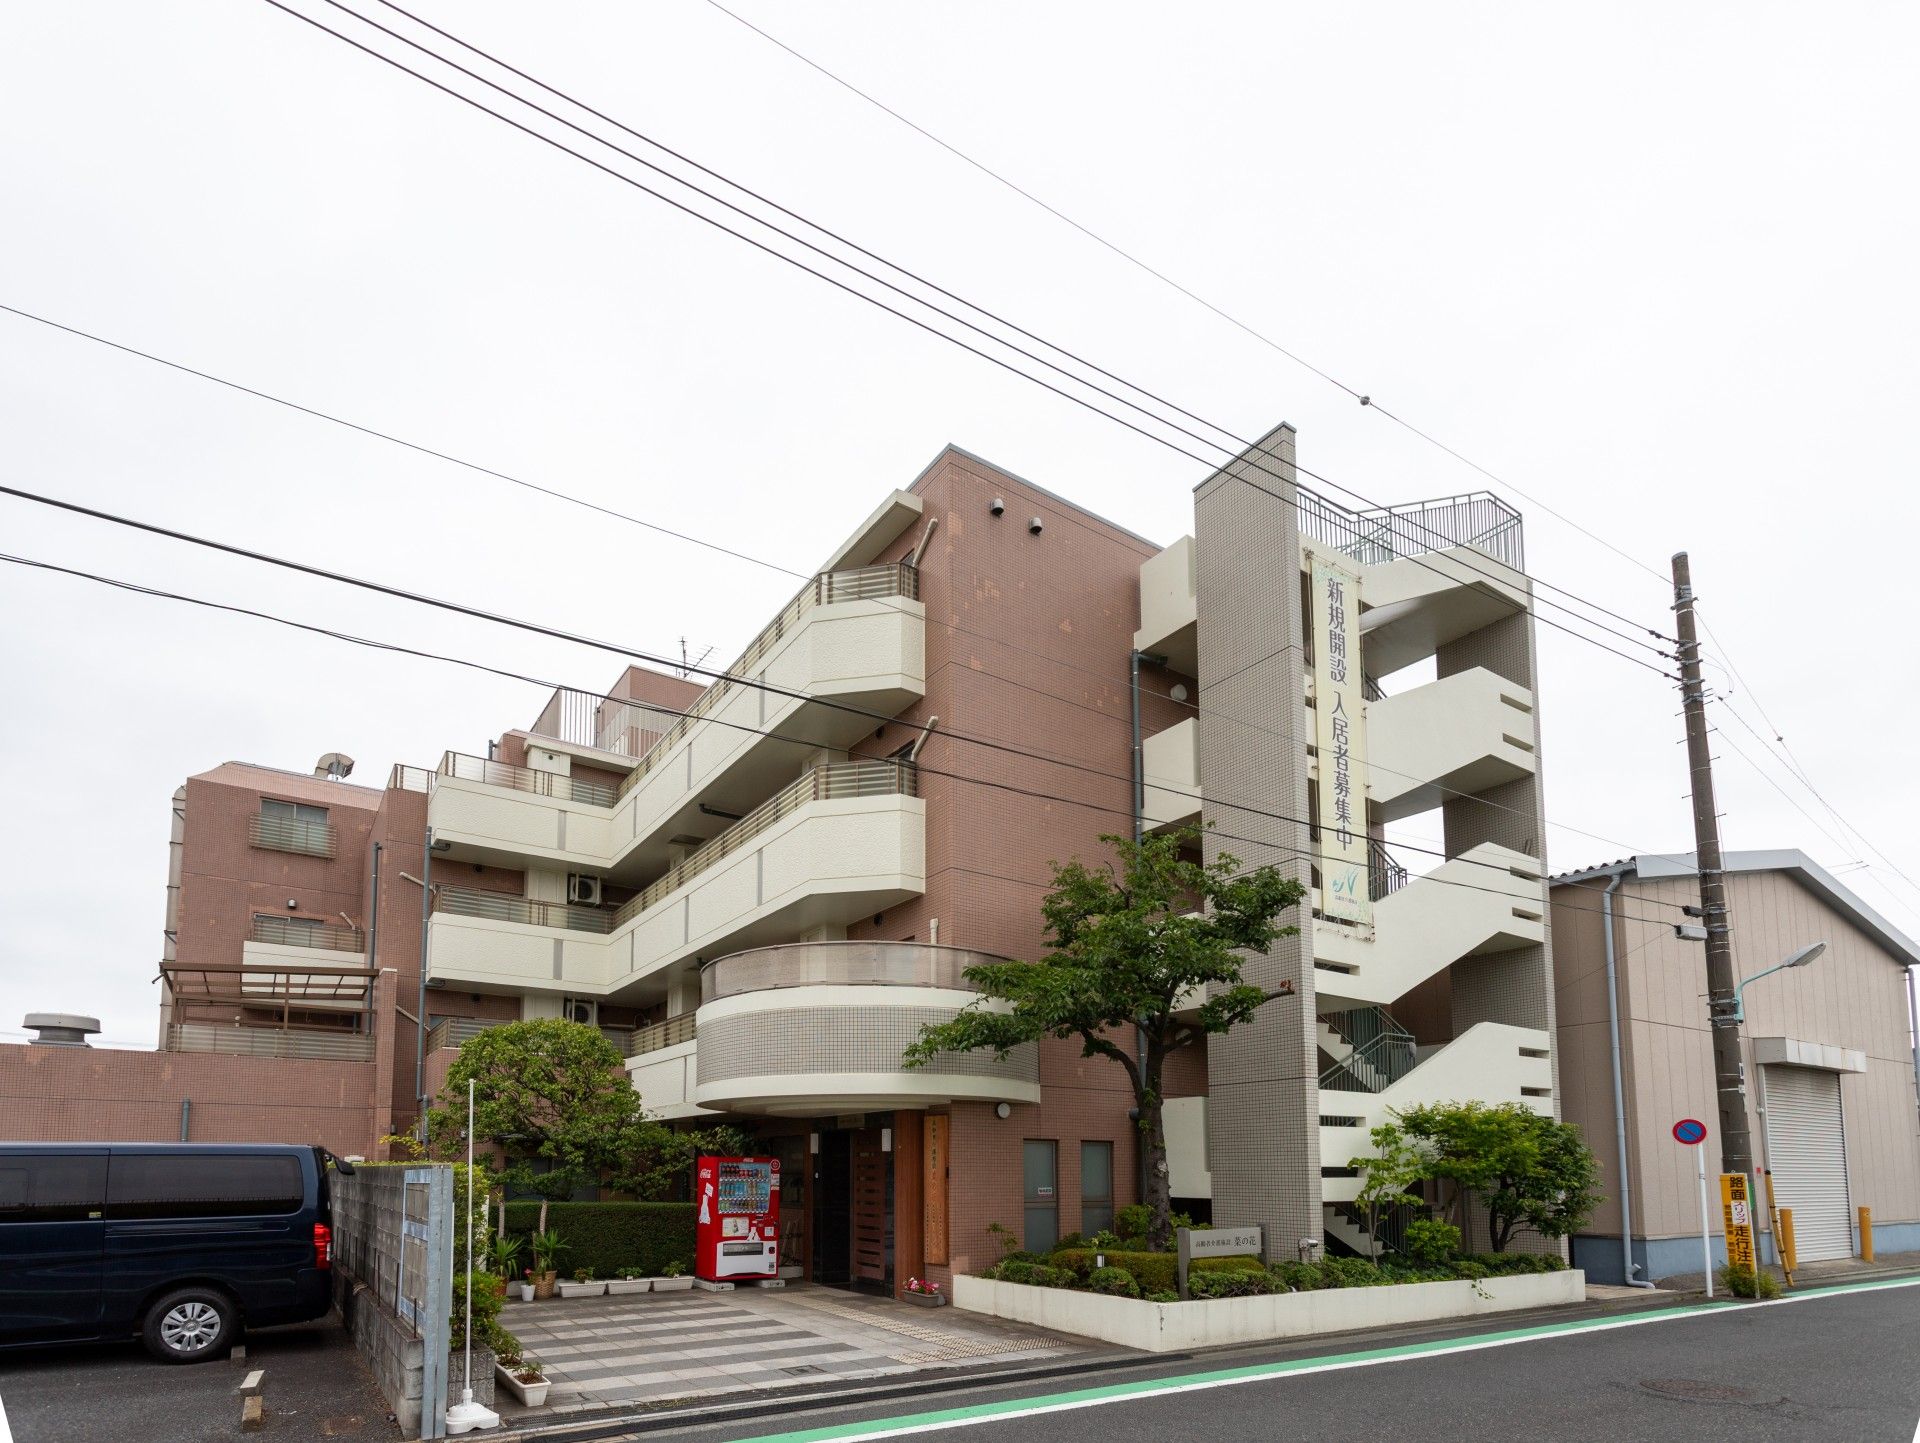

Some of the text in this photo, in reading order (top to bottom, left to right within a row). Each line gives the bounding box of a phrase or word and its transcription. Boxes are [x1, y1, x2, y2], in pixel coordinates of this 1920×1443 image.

[1327, 577, 1352, 851] 新規開設 入居者募集中
[1234, 1235, 1257, 1247] 菜の花
